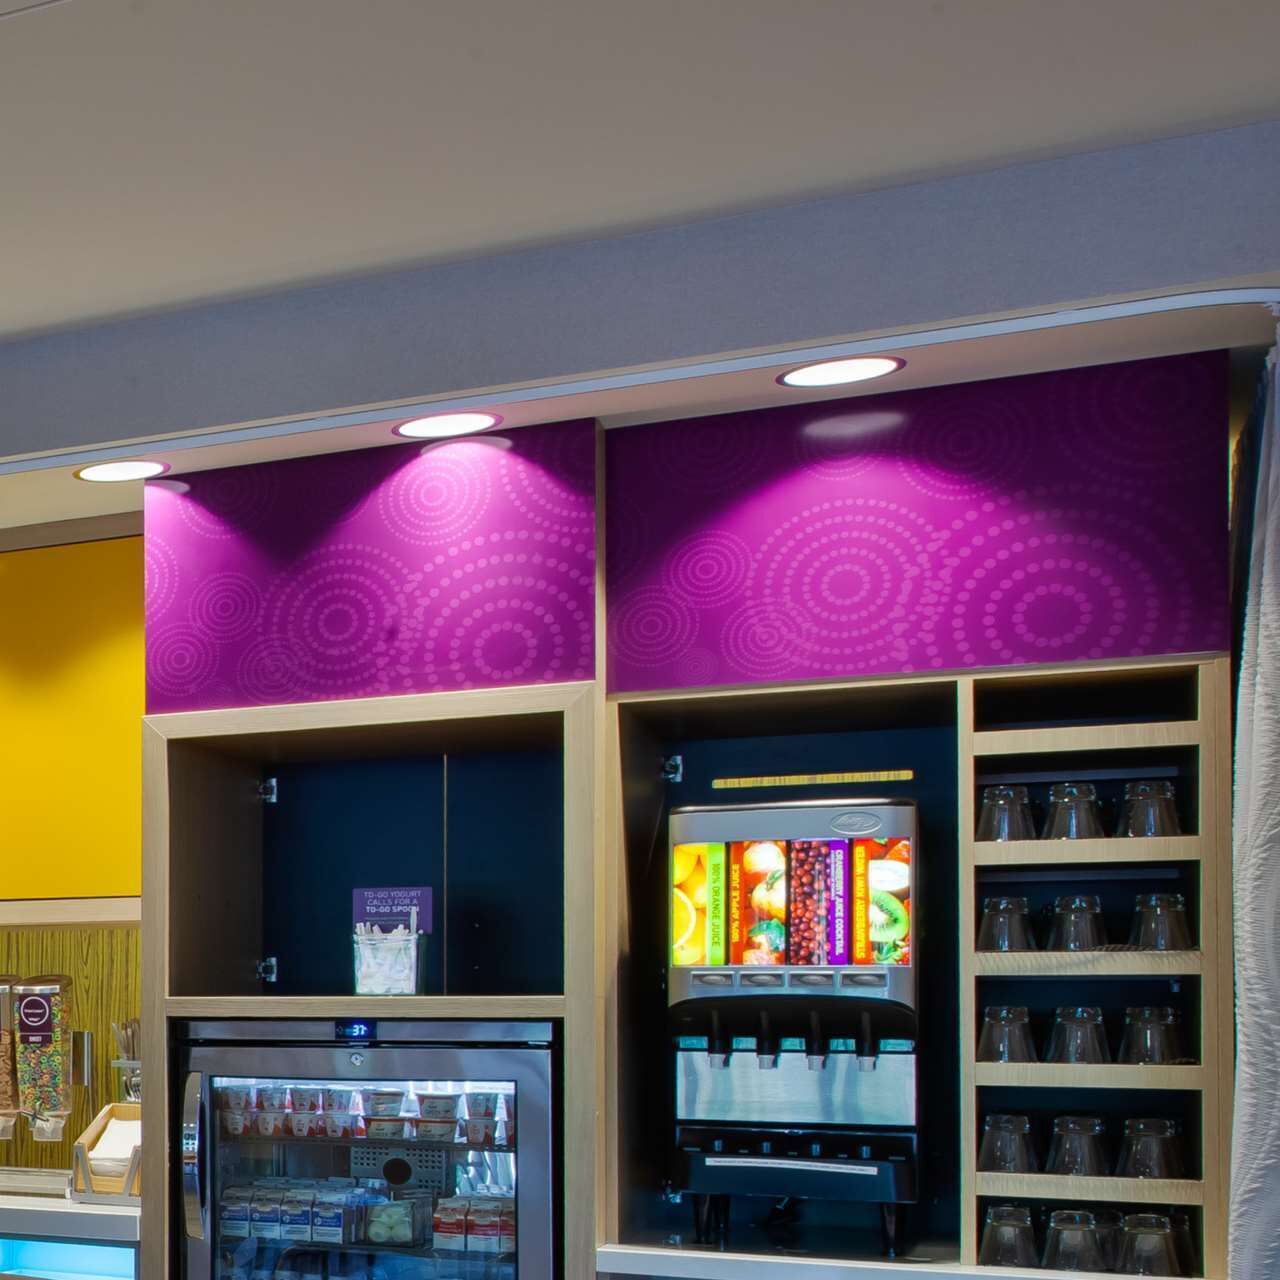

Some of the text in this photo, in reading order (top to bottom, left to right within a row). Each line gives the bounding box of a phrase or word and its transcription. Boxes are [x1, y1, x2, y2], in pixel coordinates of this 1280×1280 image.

[731, 863, 740, 889] JUICE
[390, 890, 422, 898] YOGURT
[712, 886, 721, 920] ORANGE
[731, 890, 740, 920] APPLE
[835, 896, 844, 918] JUICE
[712, 921, 721, 947] JUICE
[835, 918, 844, 956] COCKTAIL
